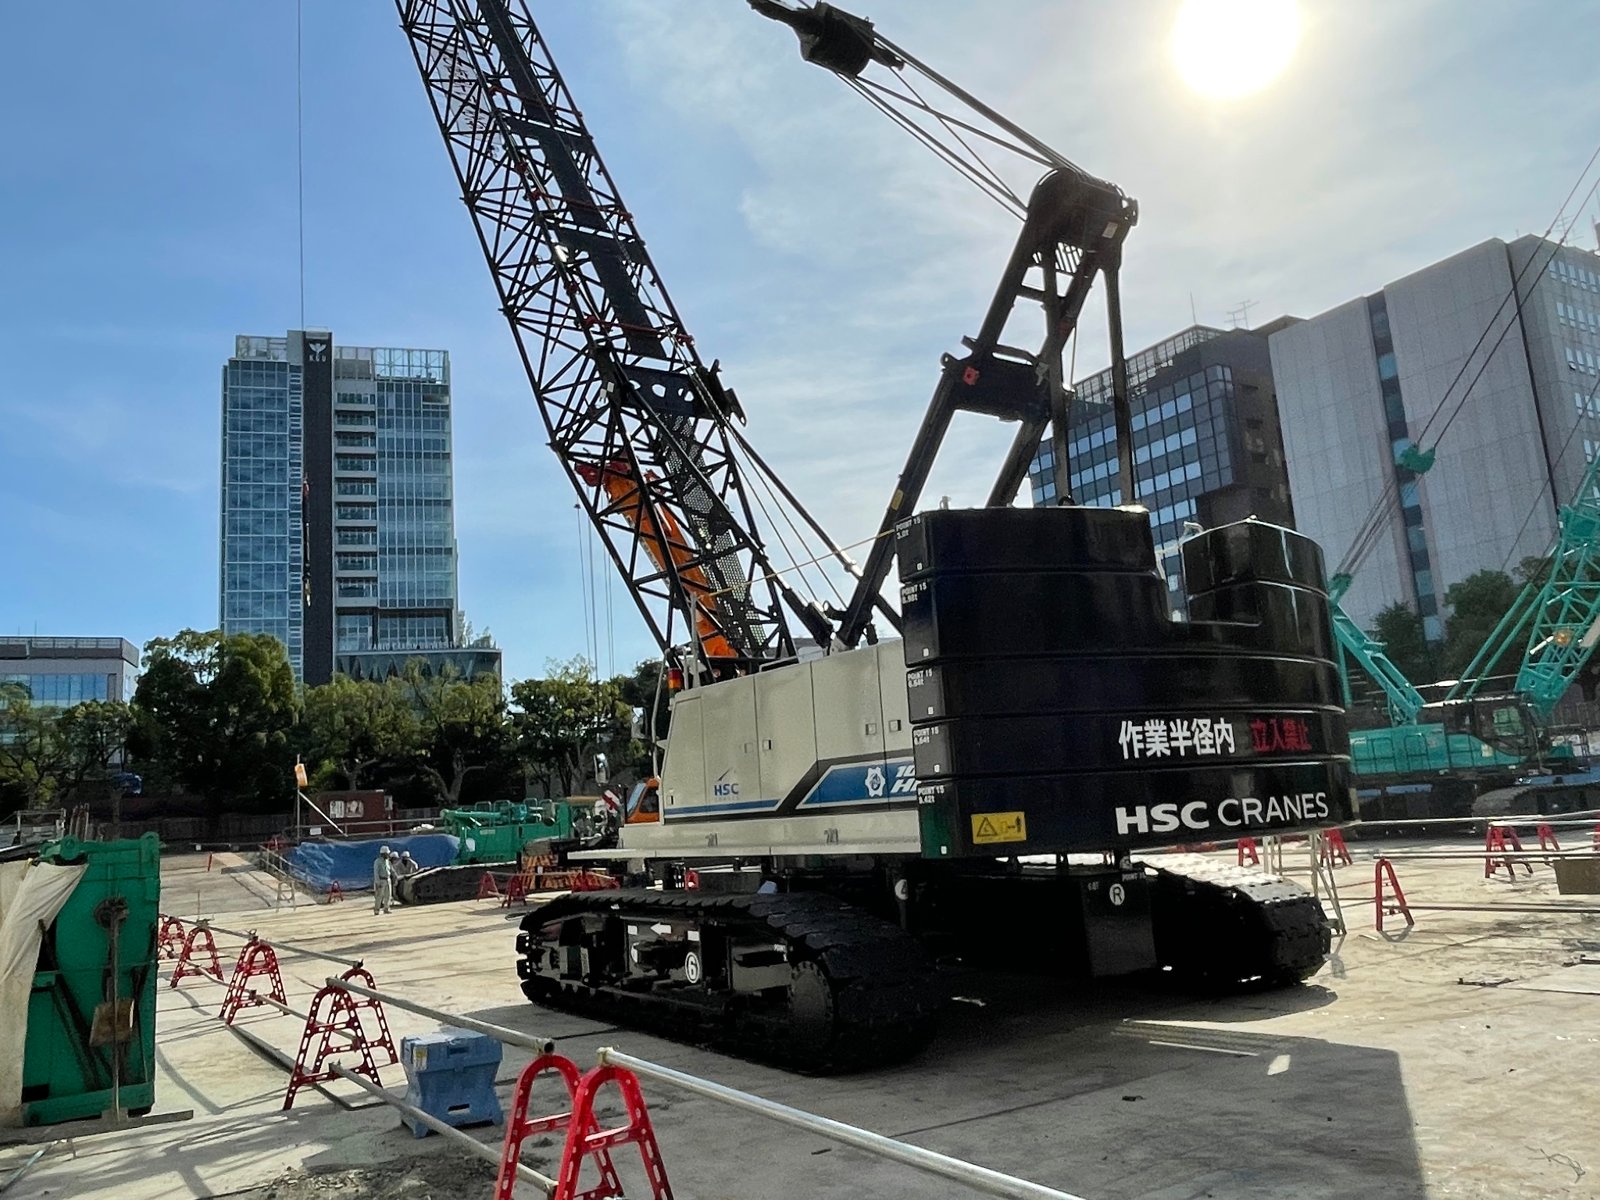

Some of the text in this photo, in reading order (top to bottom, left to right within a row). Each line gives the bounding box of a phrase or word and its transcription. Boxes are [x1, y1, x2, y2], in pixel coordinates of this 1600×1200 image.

[896, 519, 912, 531] POINT
[901, 582, 927, 596] POINT 15
[908, 668, 933, 680] POINT 15
[913, 726, 939, 738] POINT 15
[1118, 717, 1312, 760] 作業半径内 立入禁止
[714, 783, 739, 796] HSC
[918, 784, 945, 797] POINT 15
[1115, 792, 1329, 835] HSC CRANES
[1111, 885, 1124, 904] R
[687, 955, 699, 980] 6
